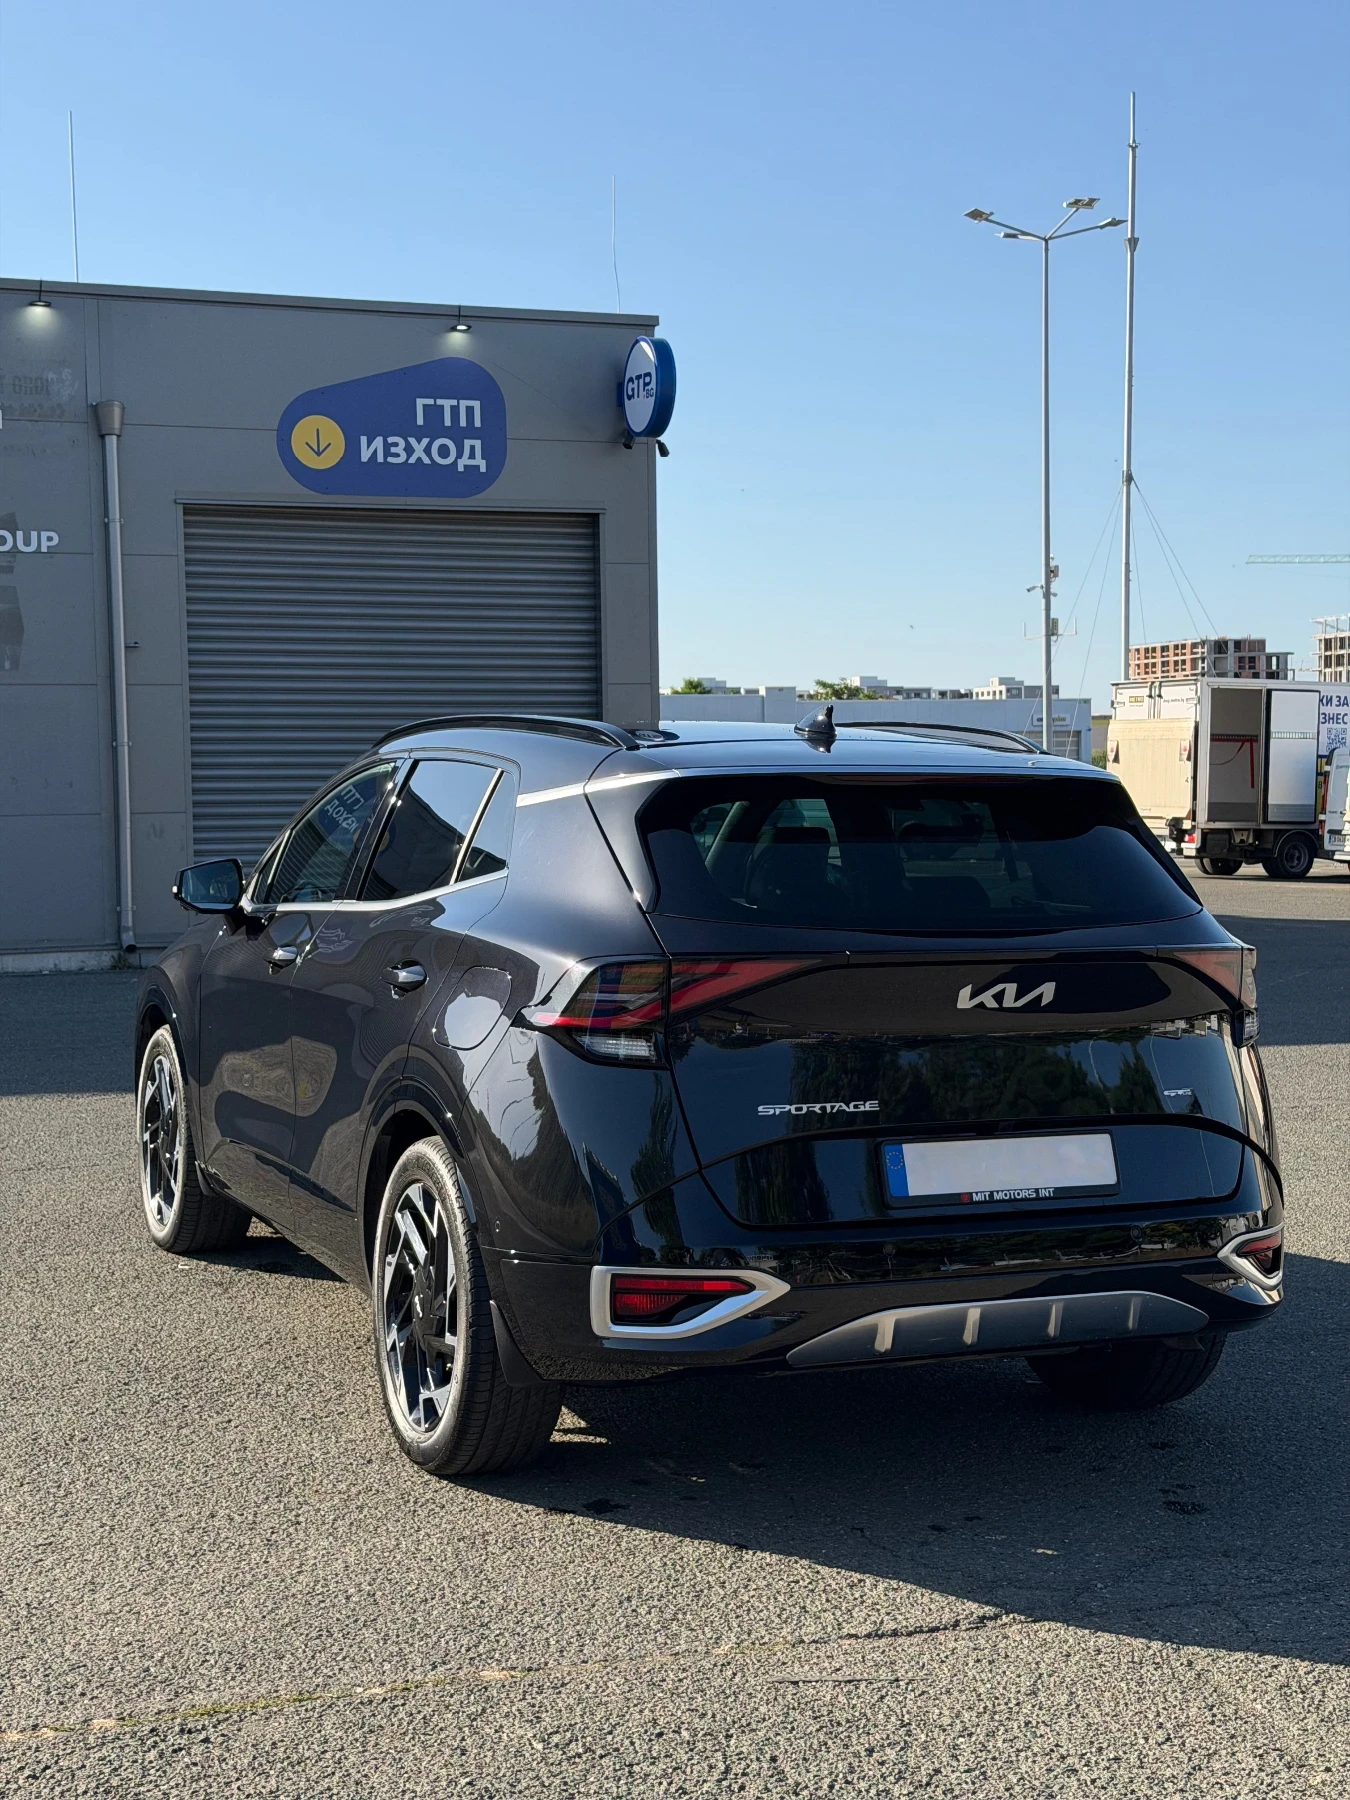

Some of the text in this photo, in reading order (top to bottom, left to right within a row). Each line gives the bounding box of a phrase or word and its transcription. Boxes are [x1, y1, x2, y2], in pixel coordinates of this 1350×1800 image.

[415, 398, 482, 428] ГТП
[360, 435, 487, 473] ИЗХОД
[1335, 694, 1350, 708] ЗА
[956, 981, 1056, 1009] KIA
[757, 1099, 881, 1117] SPORTAGE
[972, 1188, 1055, 1202] MIT MOTORS INT
